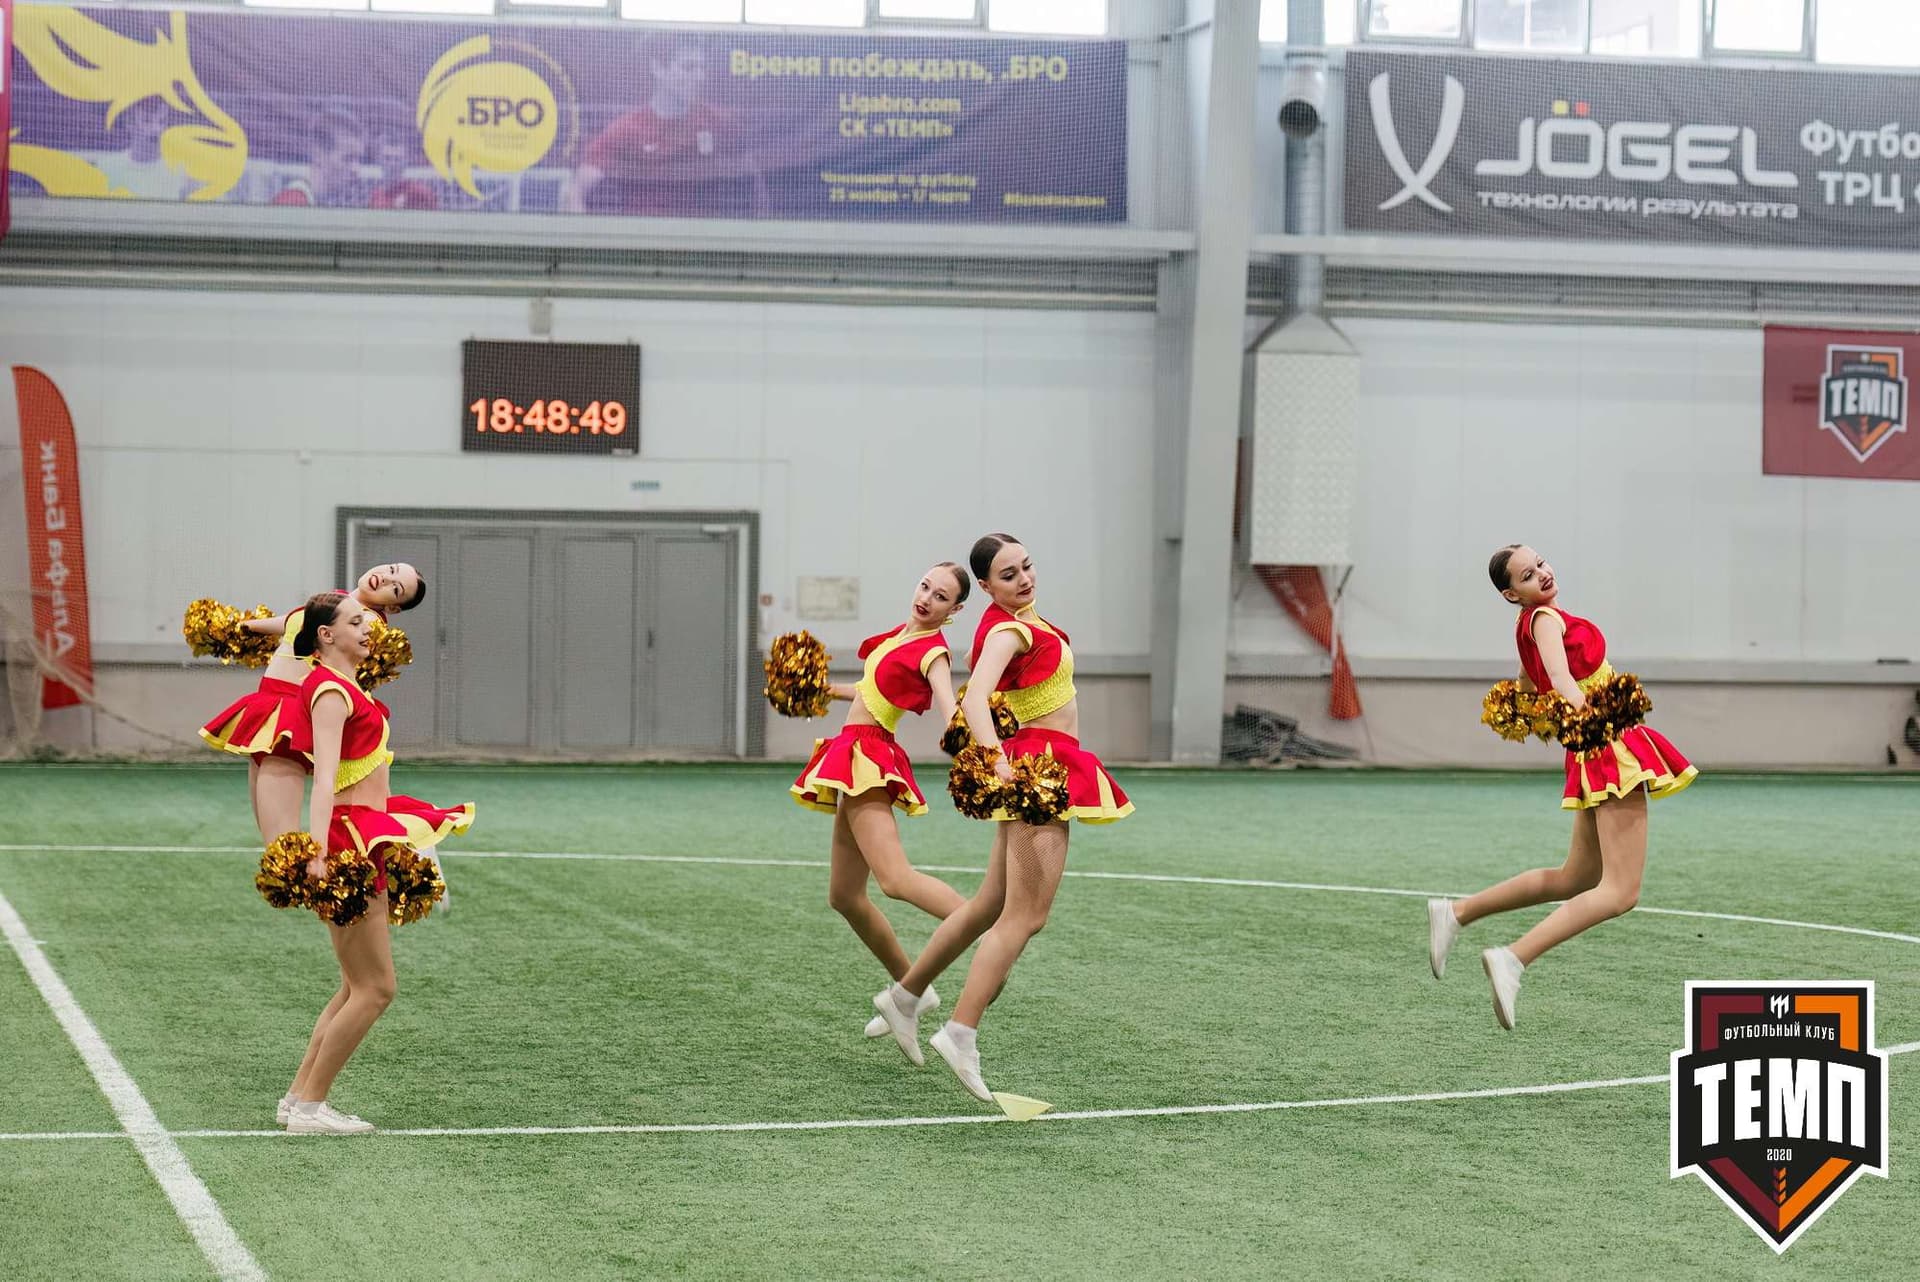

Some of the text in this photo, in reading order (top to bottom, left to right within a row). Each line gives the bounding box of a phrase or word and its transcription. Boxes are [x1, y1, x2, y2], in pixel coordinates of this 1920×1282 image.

[732, 50, 820, 80] Время
[830, 54, 992, 84] побеждать,
[1475, 100, 1798, 187] JÖGEL
[1477, 191, 1798, 219] технологии результата
[1818, 171, 1904, 213] ТРЦ
[470, 398, 626, 435] 18:48:49
[1829, 378, 1899, 419] ТЕМП
